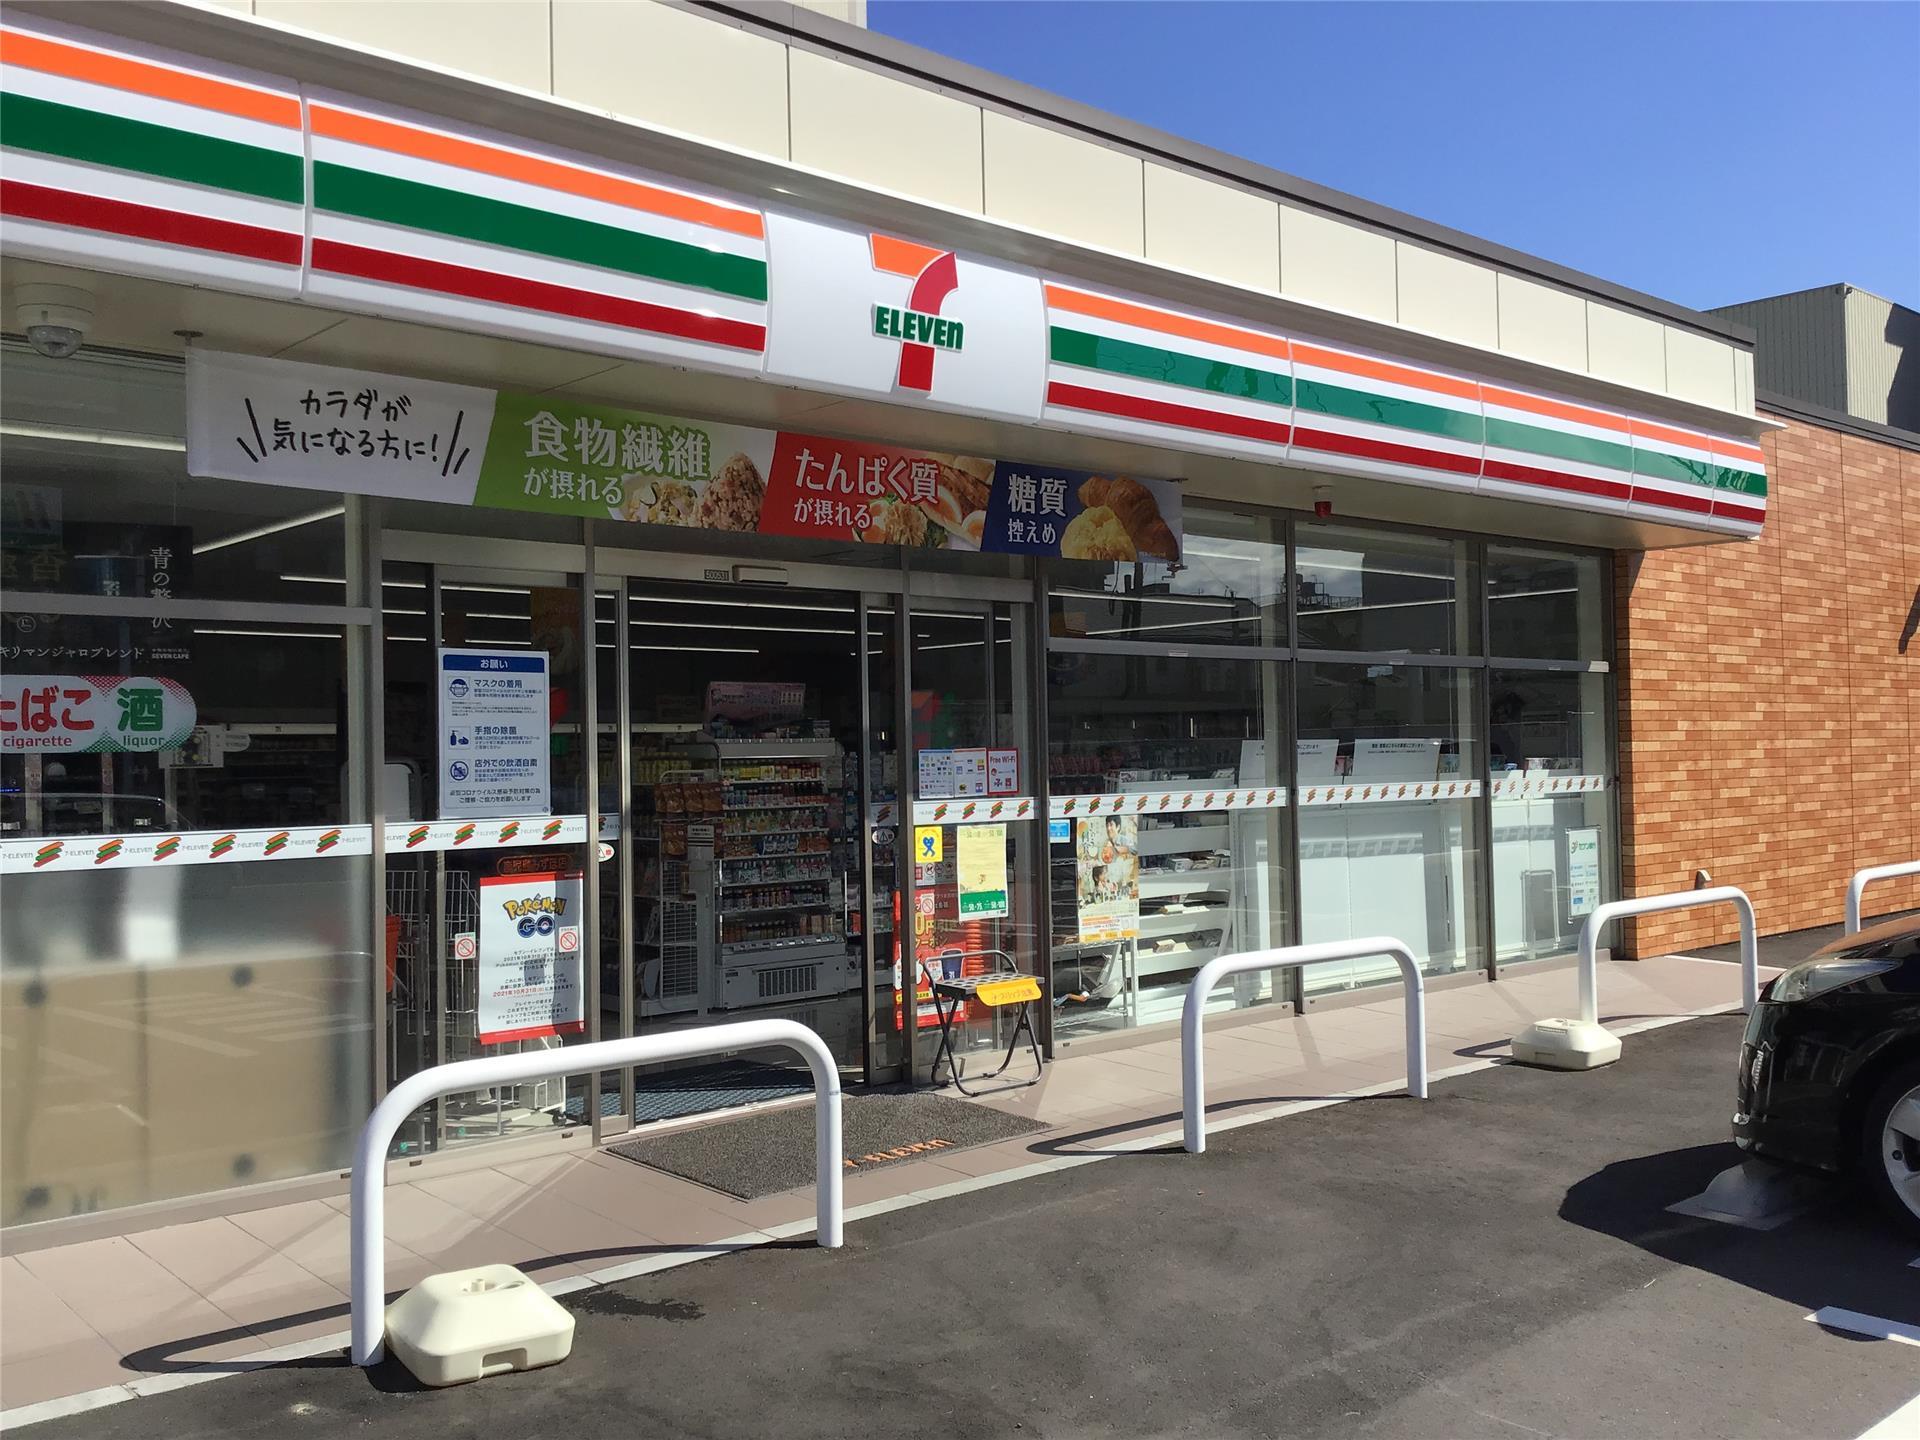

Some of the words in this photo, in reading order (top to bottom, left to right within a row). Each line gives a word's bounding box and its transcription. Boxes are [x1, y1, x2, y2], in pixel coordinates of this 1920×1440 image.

[300, 389, 411, 422] カラダが
[272, 419, 438, 463] 気になる方に!
[523, 410, 710, 478] 食物繊維
[523, 468, 623, 504] が摂れる
[794, 448, 939, 504] たんぱく質
[1007, 473, 1068, 517] 糖質
[793, 497, 873, 531] が摂れる
[1007, 518, 1057, 546] 控えめ
[480, 659, 509, 670] お願い
[474, 679, 523, 689] マスクの着用
[117, 688, 163, 732] 酒
[3, 735, 73, 750] cigarette
[123, 735, 165, 748] liquor
[517, 914, 555, 938] GO
